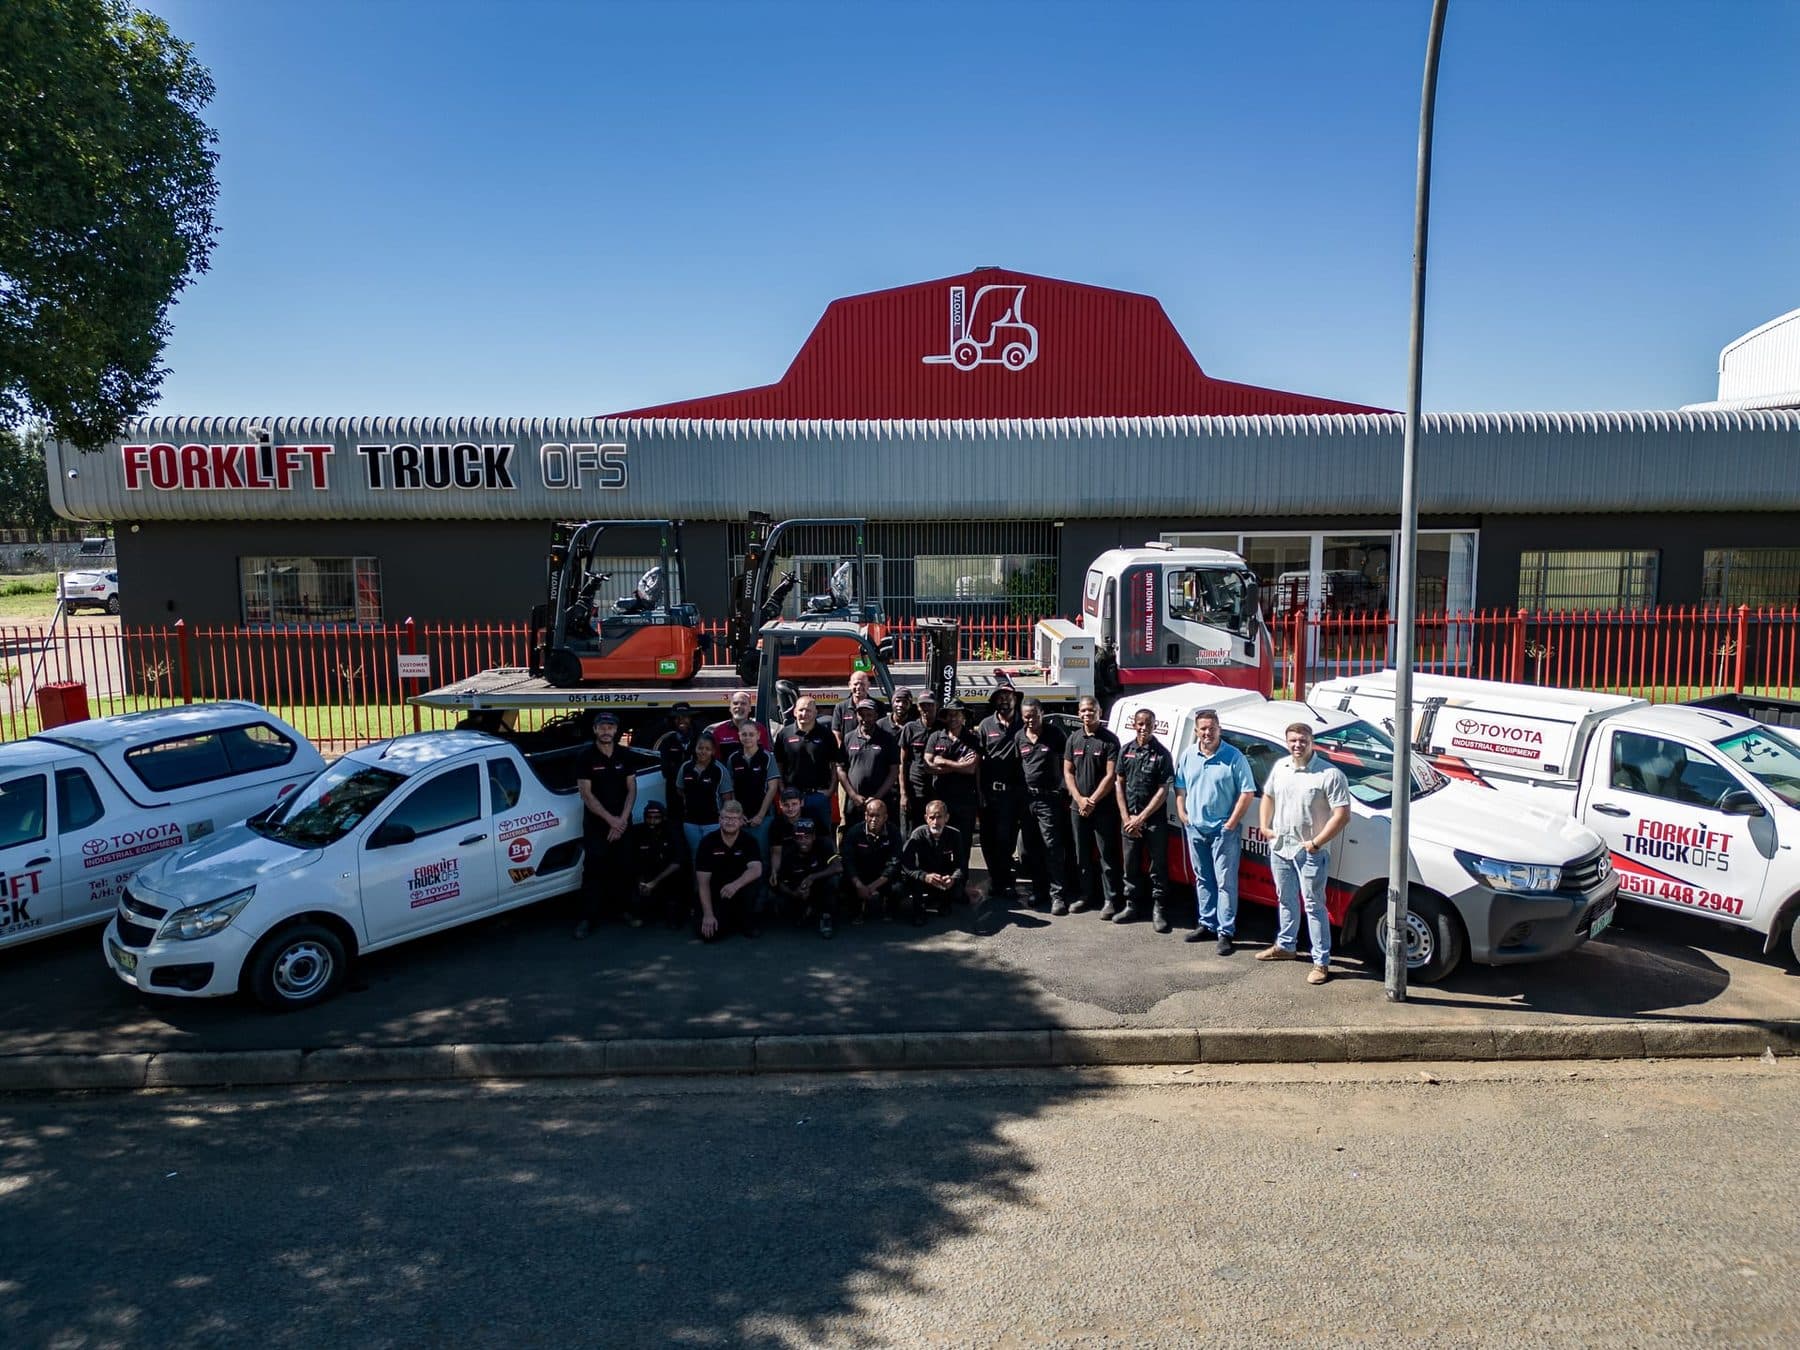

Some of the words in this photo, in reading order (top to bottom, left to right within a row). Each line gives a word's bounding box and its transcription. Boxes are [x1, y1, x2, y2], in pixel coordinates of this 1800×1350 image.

[953, 291, 962, 327] TOYOTA
[356, 442, 517, 491] TRUCK
[540, 442, 628, 490] OFS
[550, 570, 559, 600] TOYOTA
[744, 569, 754, 599] TOYOTA
[1145, 572, 1154, 612] HANDLING
[1145, 613, 1154, 652] MATERIAL
[568, 694, 589, 703] 051
[590, 694, 611, 703] 448
[613, 694, 640, 703] 2947
[943, 680, 952, 708] TOYO
[964, 689, 989, 697] 2947
[1479, 723, 1543, 745] TOYOTA
[1453, 738, 1495, 752] INDUSTRIAL
[1495, 744, 1538, 758] EQUIPMENT
[513, 810, 555, 827] TOYOTA
[110, 822, 181, 849] TOYOTA
[1241, 838, 1272, 857] TRUC
[86, 849, 135, 868] INDUSTRIAL
[136, 837, 182, 856] EQUIPMENT
[511, 844, 531, 856] BT
[1622, 833, 1691, 864] TRUCK
[1691, 848, 1730, 872] OFS
[89, 878, 109, 890] Tel:
[90, 886, 114, 901] A/H:
[407, 872, 441, 891] TRUCK
[425, 881, 460, 896] TOYOTA
[1658, 881, 1694, 905] 448
[1698, 889, 1745, 916] 2947
